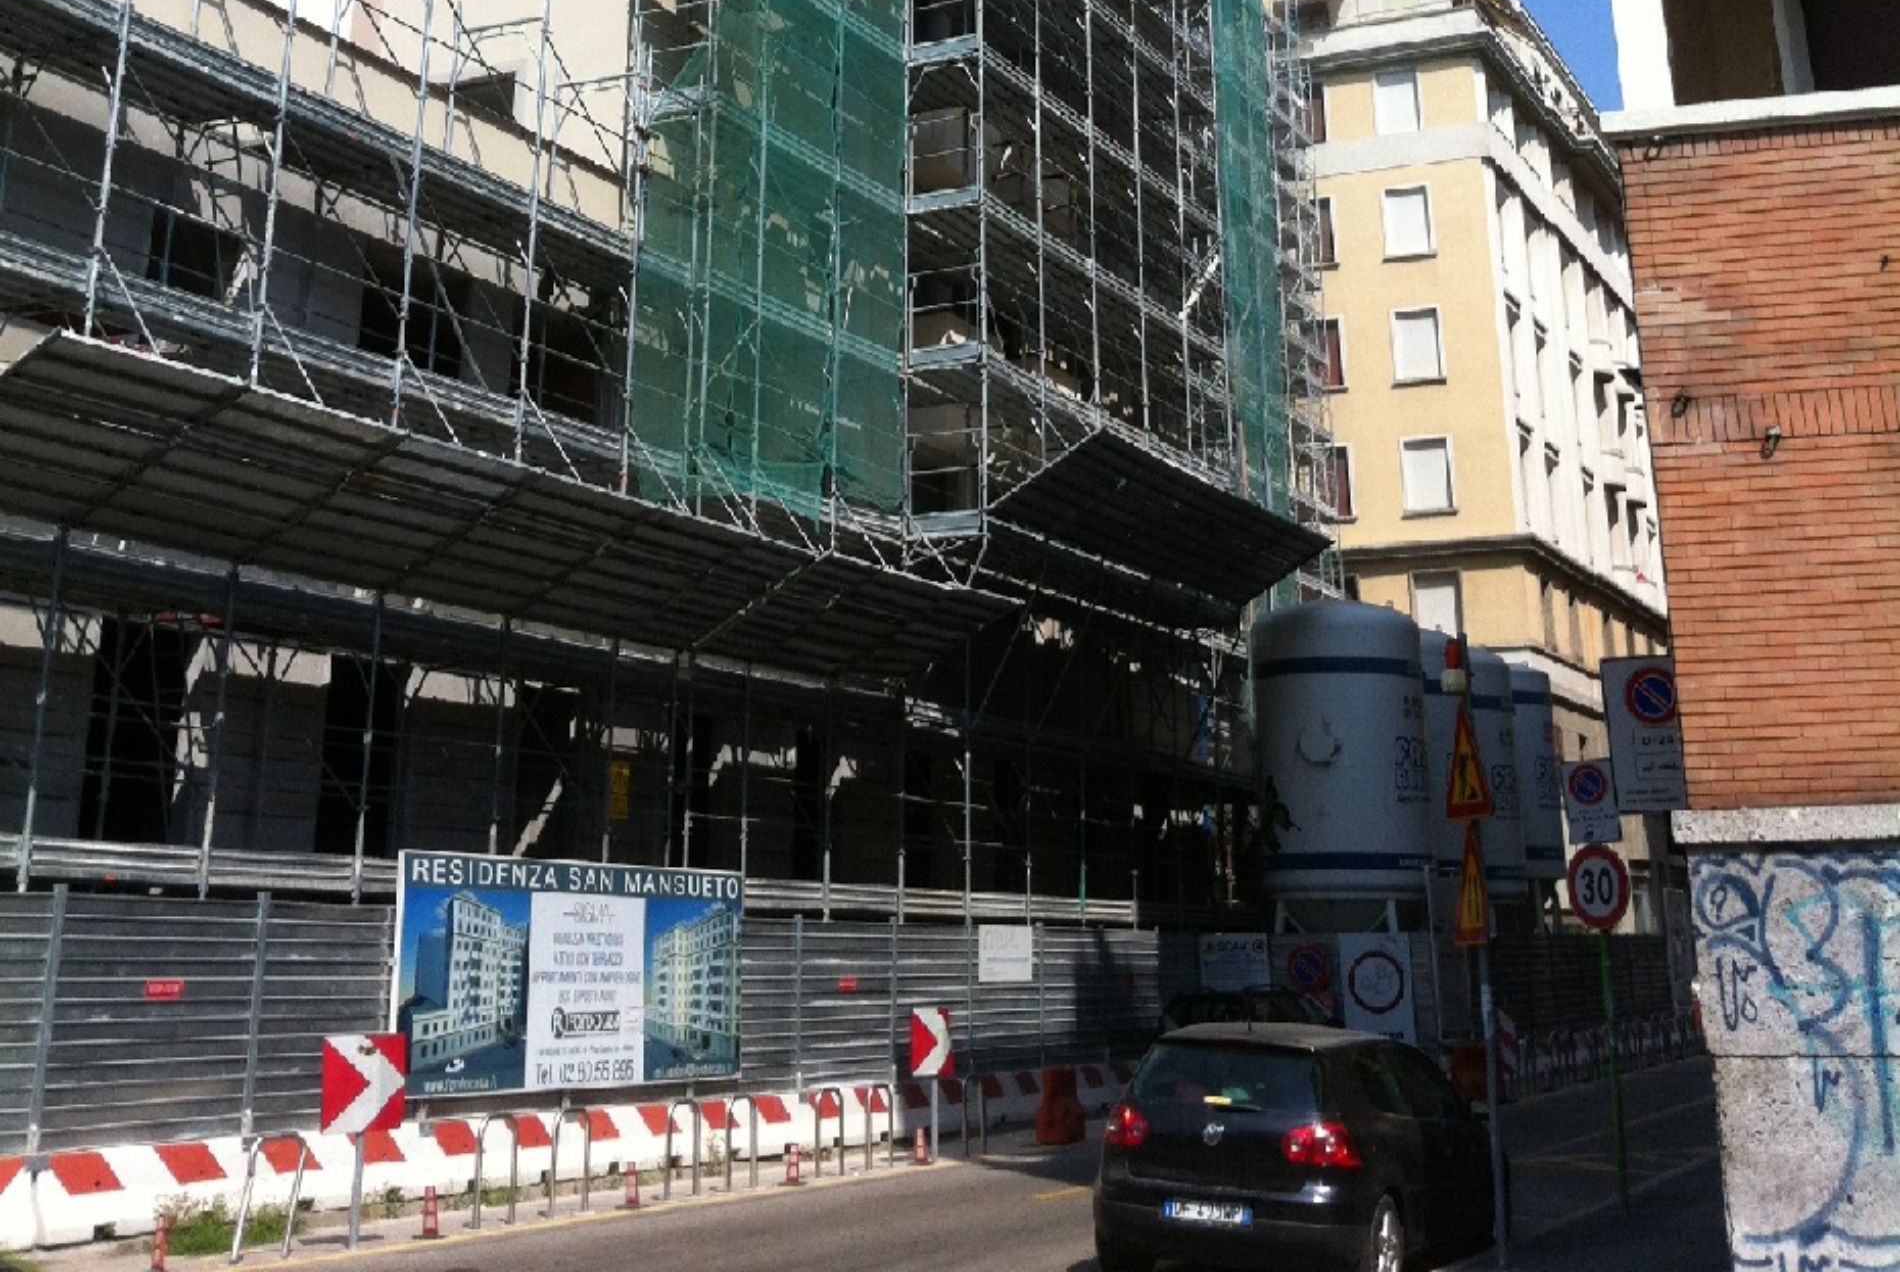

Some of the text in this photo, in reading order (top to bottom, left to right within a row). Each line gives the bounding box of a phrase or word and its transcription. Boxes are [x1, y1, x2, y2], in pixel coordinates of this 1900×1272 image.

[411, 858, 738, 899] RESIDENZA SAN MANSUETO
[1581, 867, 1613, 905] 30
